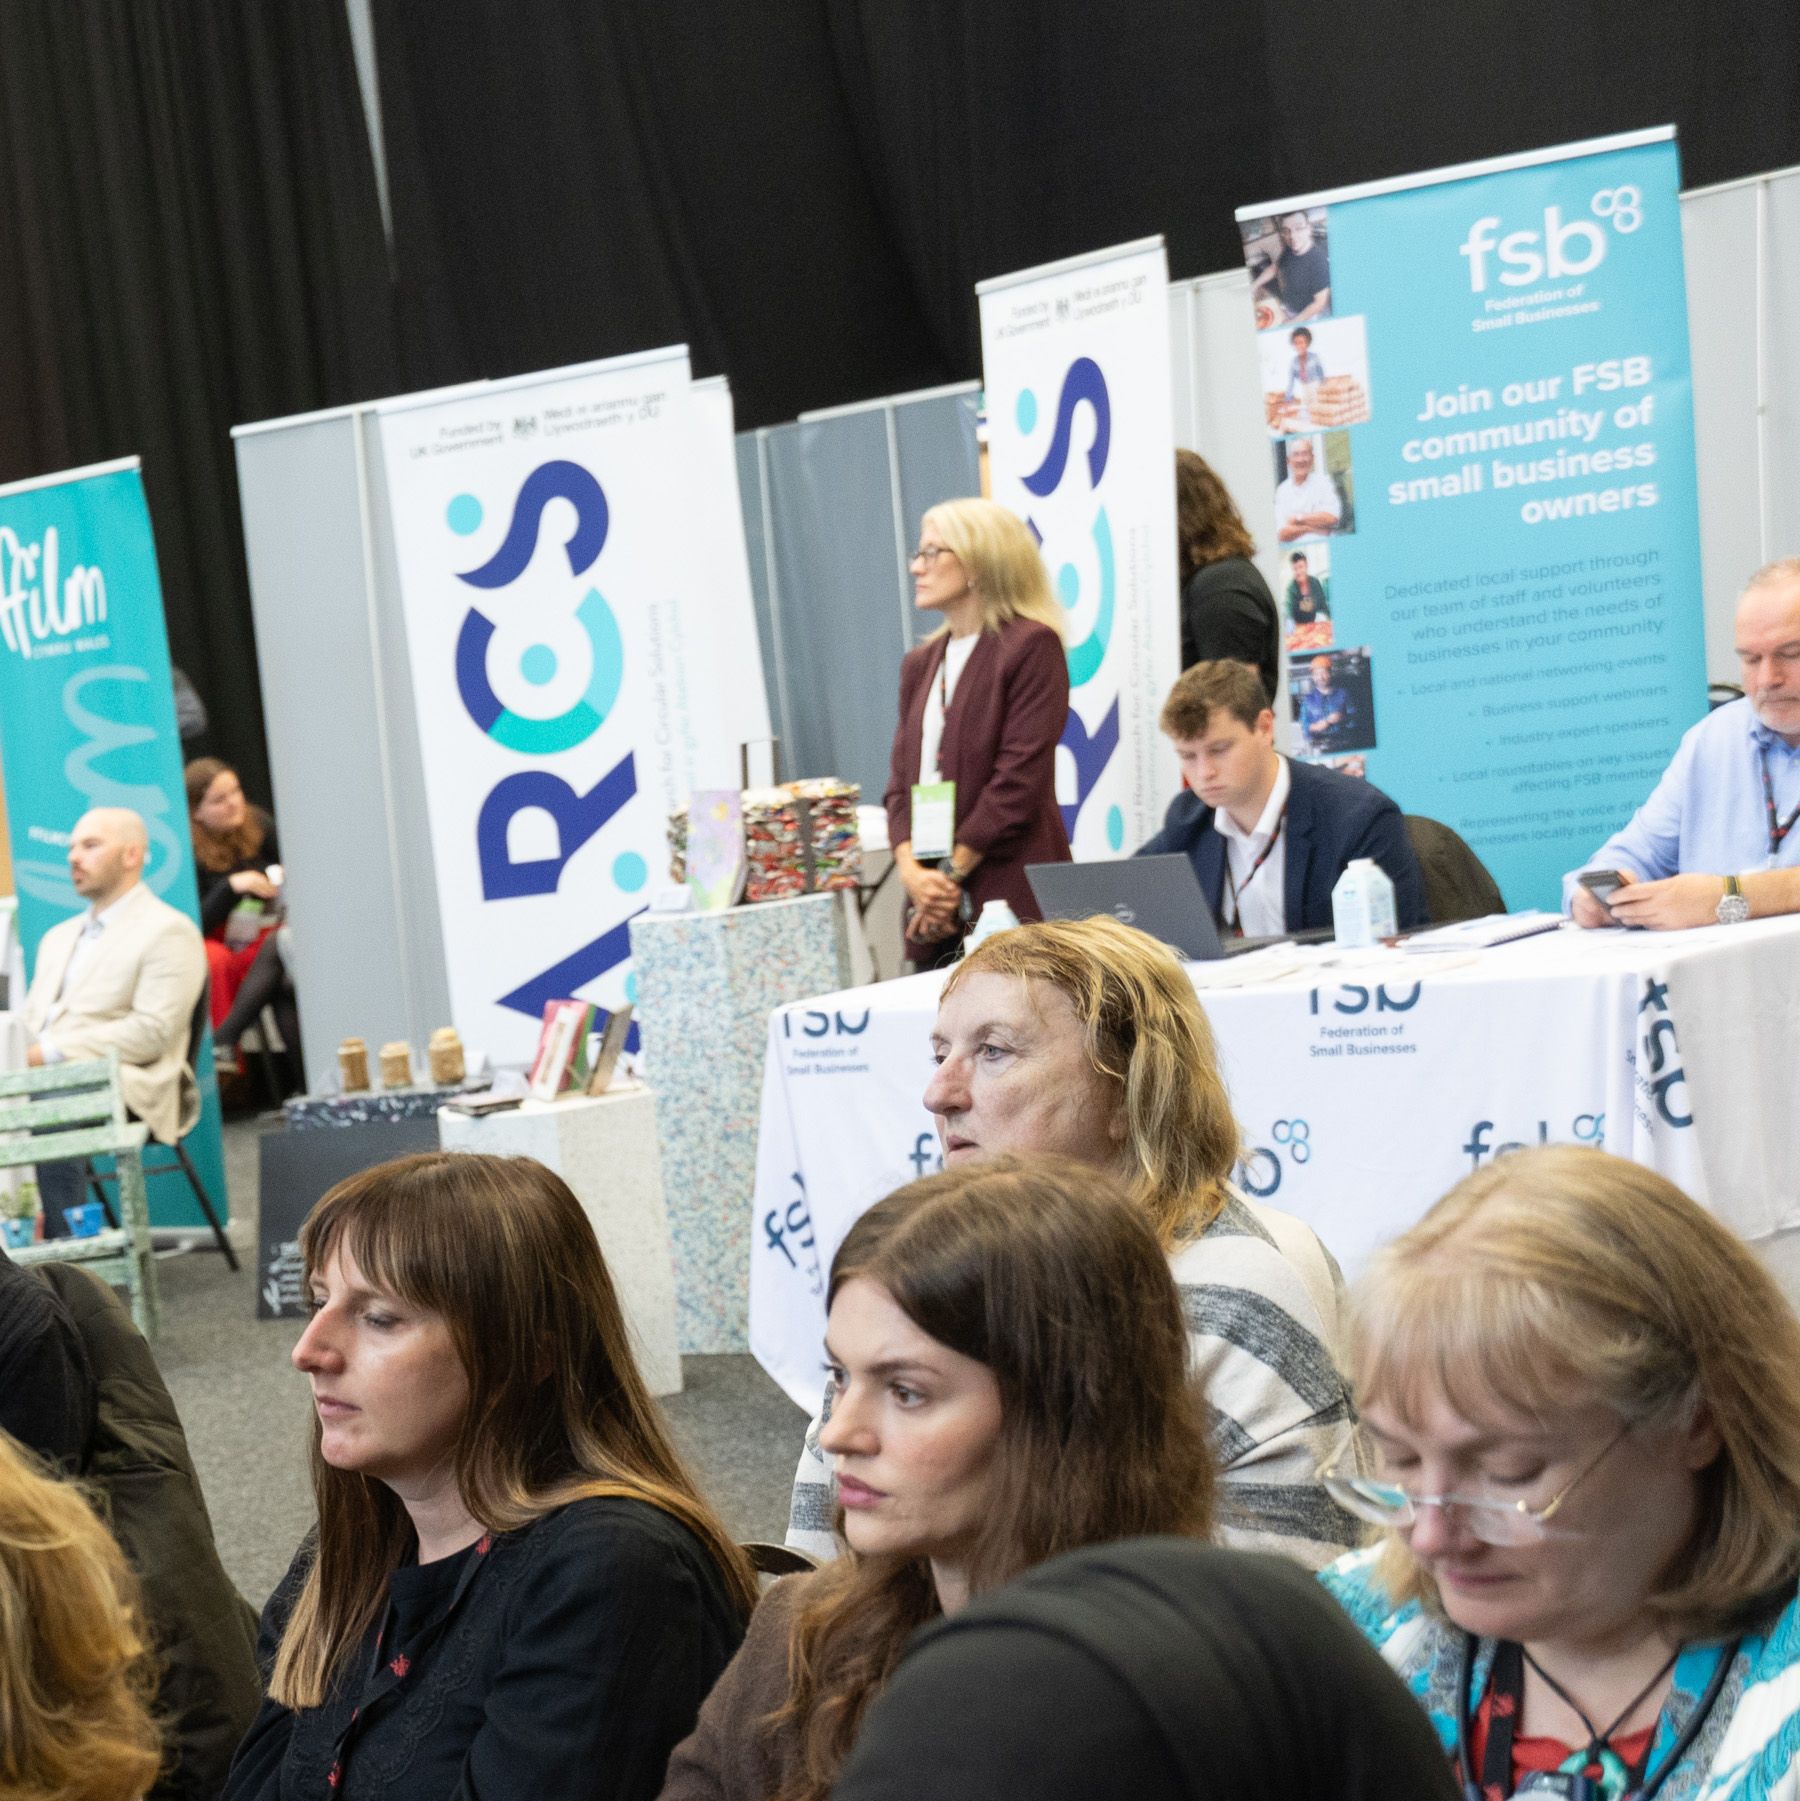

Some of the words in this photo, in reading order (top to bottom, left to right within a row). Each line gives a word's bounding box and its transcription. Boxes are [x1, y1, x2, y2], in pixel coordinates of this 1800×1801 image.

[1459, 205, 1606, 292] fsb
[1472, 311, 1514, 333] Small
[1517, 300, 1600, 326] Businesses
[1485, 286, 1563, 312] Federation
[1567, 283, 1585, 298] of
[1417, 385, 1492, 423] Join
[1501, 373, 1564, 407] our
[1573, 354, 1652, 395] FSB
[1401, 404, 1606, 464] community
[1614, 395, 1654, 429] of
[1387, 458, 1483, 505] small
[1491, 442, 1656, 490] business
[1520, 483, 1657, 525] owners
[1384, 573, 1471, 600] Dedicated
[1475, 568, 1515, 588] local
[1519, 558, 1586, 581] support
[1589, 547, 1660, 571] through
[1390, 605, 1417, 622] our
[1422, 599, 1464, 618] team
[1469, 595, 1487, 610] of
[1491, 588, 1528, 608] staff
[1531, 583, 1564, 603] and
[1567, 572, 1661, 598] volunteers
[1410, 623, 1448, 642] who
[1452, 610, 1549, 636] understand
[1552, 605, 1580, 622] the
[1584, 597, 1640, 619] needs
[1644, 592, 1666, 609] of
[1406, 639, 1501, 666] businesses
[1505, 634, 1521, 651] in
[1524, 632, 1565, 653] your
[1567, 616, 1666, 644] community
[1410, 680, 1448, 697] Local
[1451, 676, 1477, 690] and
[1480, 668, 1535, 687] national
[1537, 659, 1614, 682] networking
[1617, 651, 1667, 668] events
[1482, 699, 1543, 719] Business
[1547, 692, 1600, 714] support
[1602, 683, 1668, 703] webinars
[1499, 728, 1554, 749] Industry
[1556, 721, 1601, 741] expert
[1604, 714, 1670, 736] speakers
[1452, 767, 1489, 785] Local
[1574, 771, 1602, 786] FSB
[1605, 766, 1664, 785] member
[1309, 1043, 1343, 1058] Small
[1346, 1039, 1417, 1056] Businesses
[1320, 1023, 1387, 1039] Federation
[1391, 1023, 1405, 1037] of
[793, 1046, 845, 1060] Federation
[847, 1045, 859, 1058] of
[814, 1062, 870, 1076] Businesses
